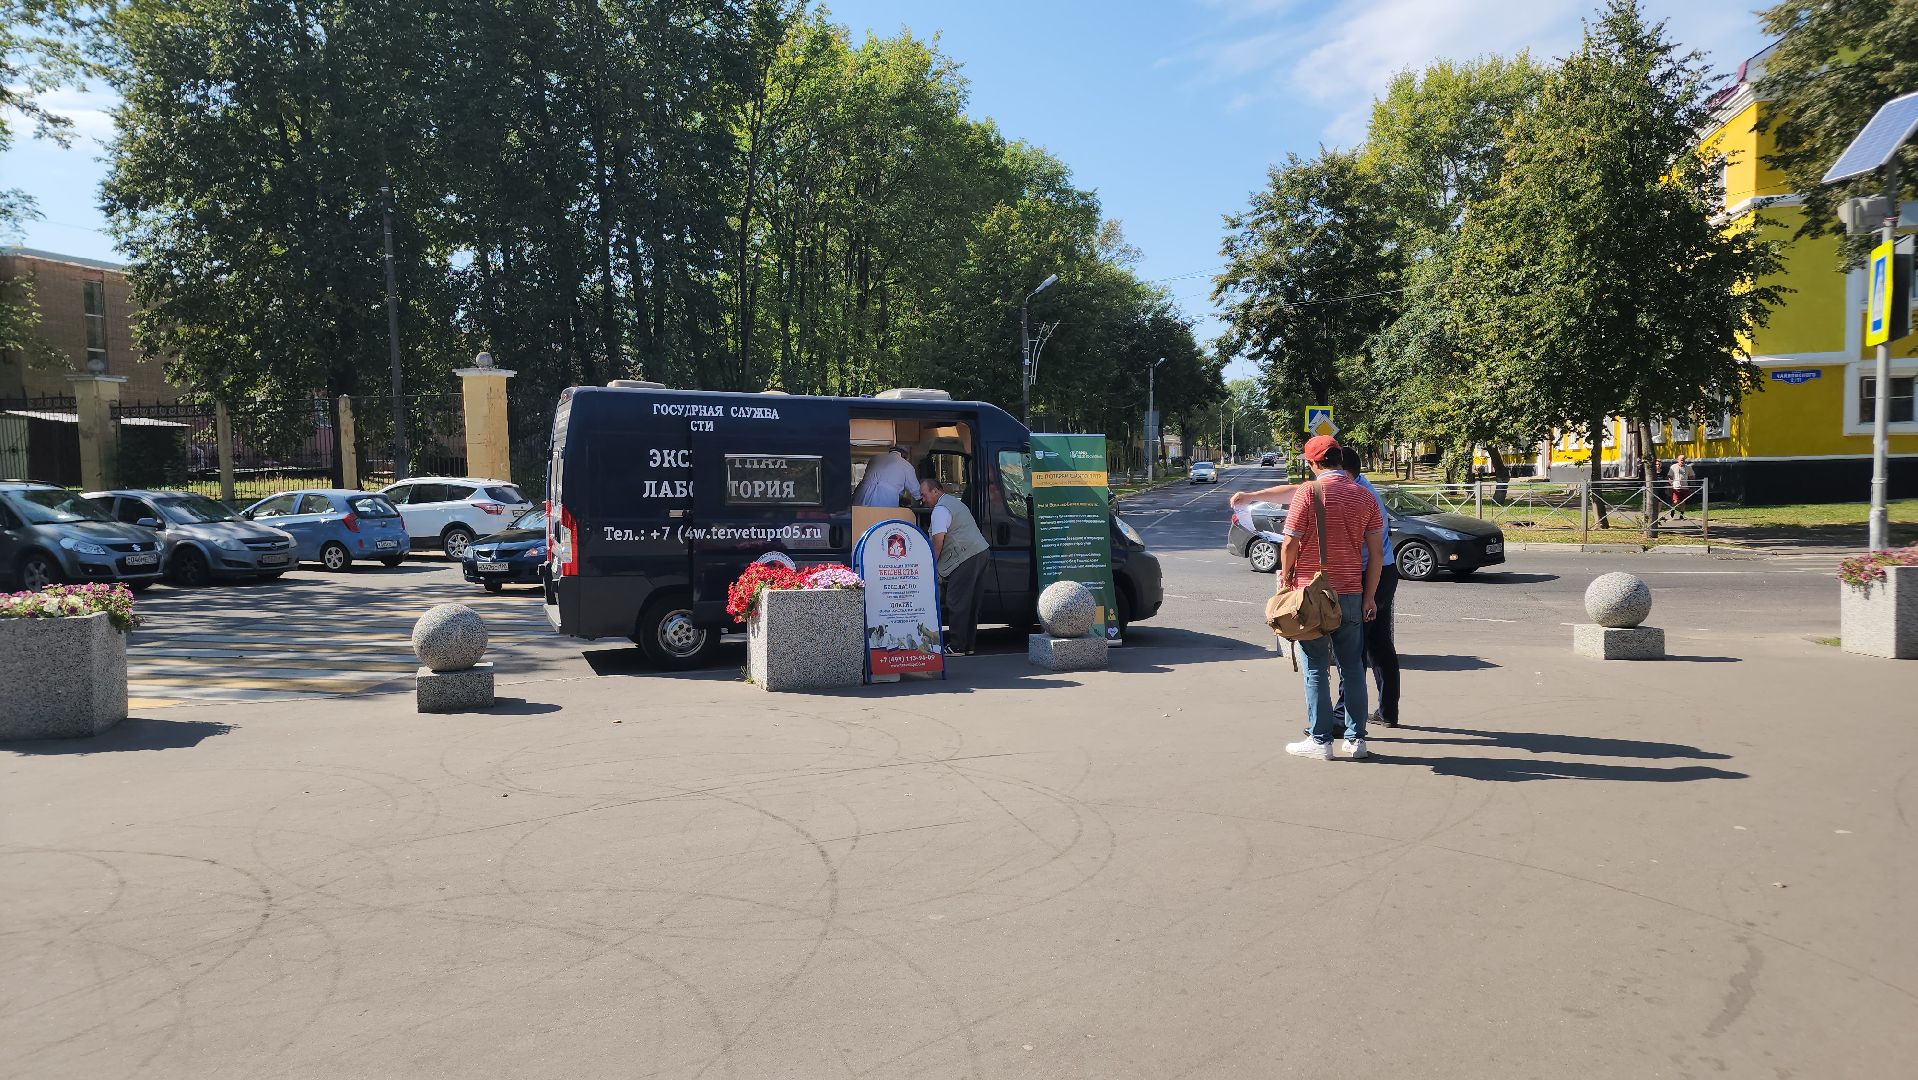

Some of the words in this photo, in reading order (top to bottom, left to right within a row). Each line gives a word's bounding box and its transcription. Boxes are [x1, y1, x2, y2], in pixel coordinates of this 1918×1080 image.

[730, 406, 780, 419] СЛУЖБА
[690, 420, 714, 431] СТИ
[649, 448, 693, 468] ЭКС
[642, 480, 694, 498] ЛАБ
[603, 526, 645, 541] Тел.:
[650, 526, 670, 541] +7
